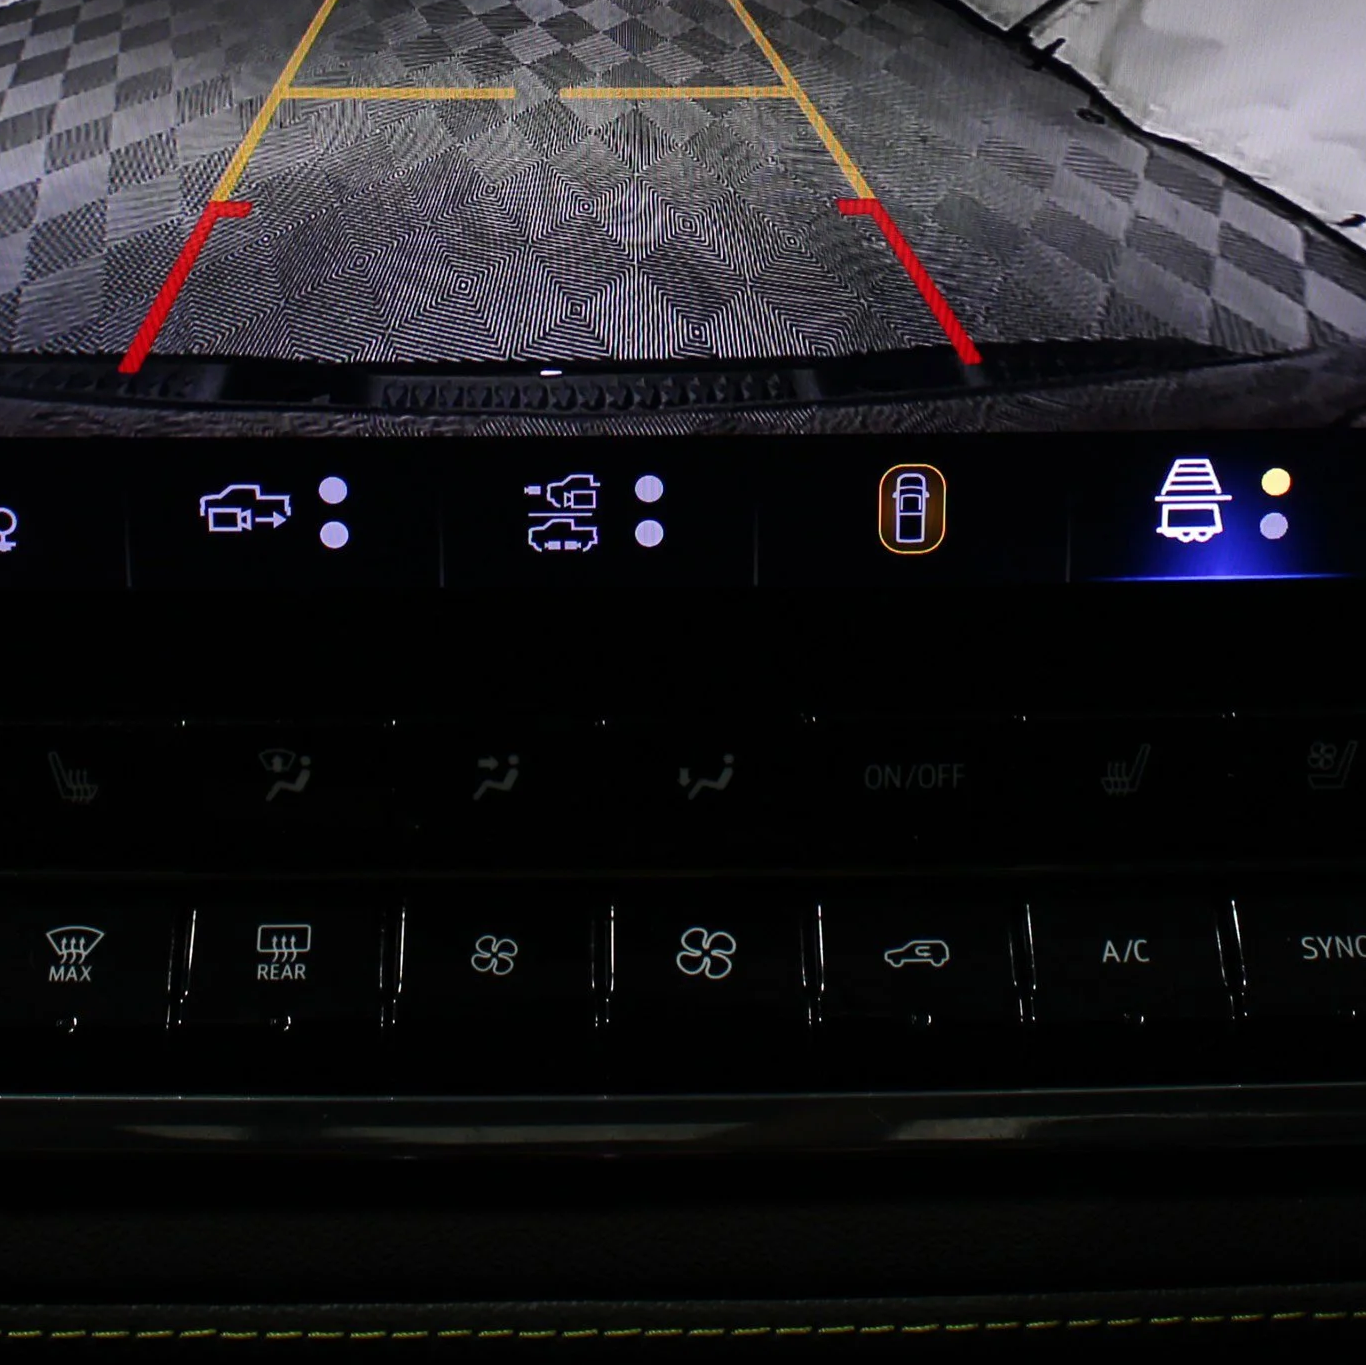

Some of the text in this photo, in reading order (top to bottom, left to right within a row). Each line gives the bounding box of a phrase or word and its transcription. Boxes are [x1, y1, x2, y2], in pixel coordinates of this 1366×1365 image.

[864, 762, 965, 791] ON/OFF
[1101, 938, 1151, 964] A/C
[47, 964, 93, 983] MAX
[256, 962, 307, 981] REAR
